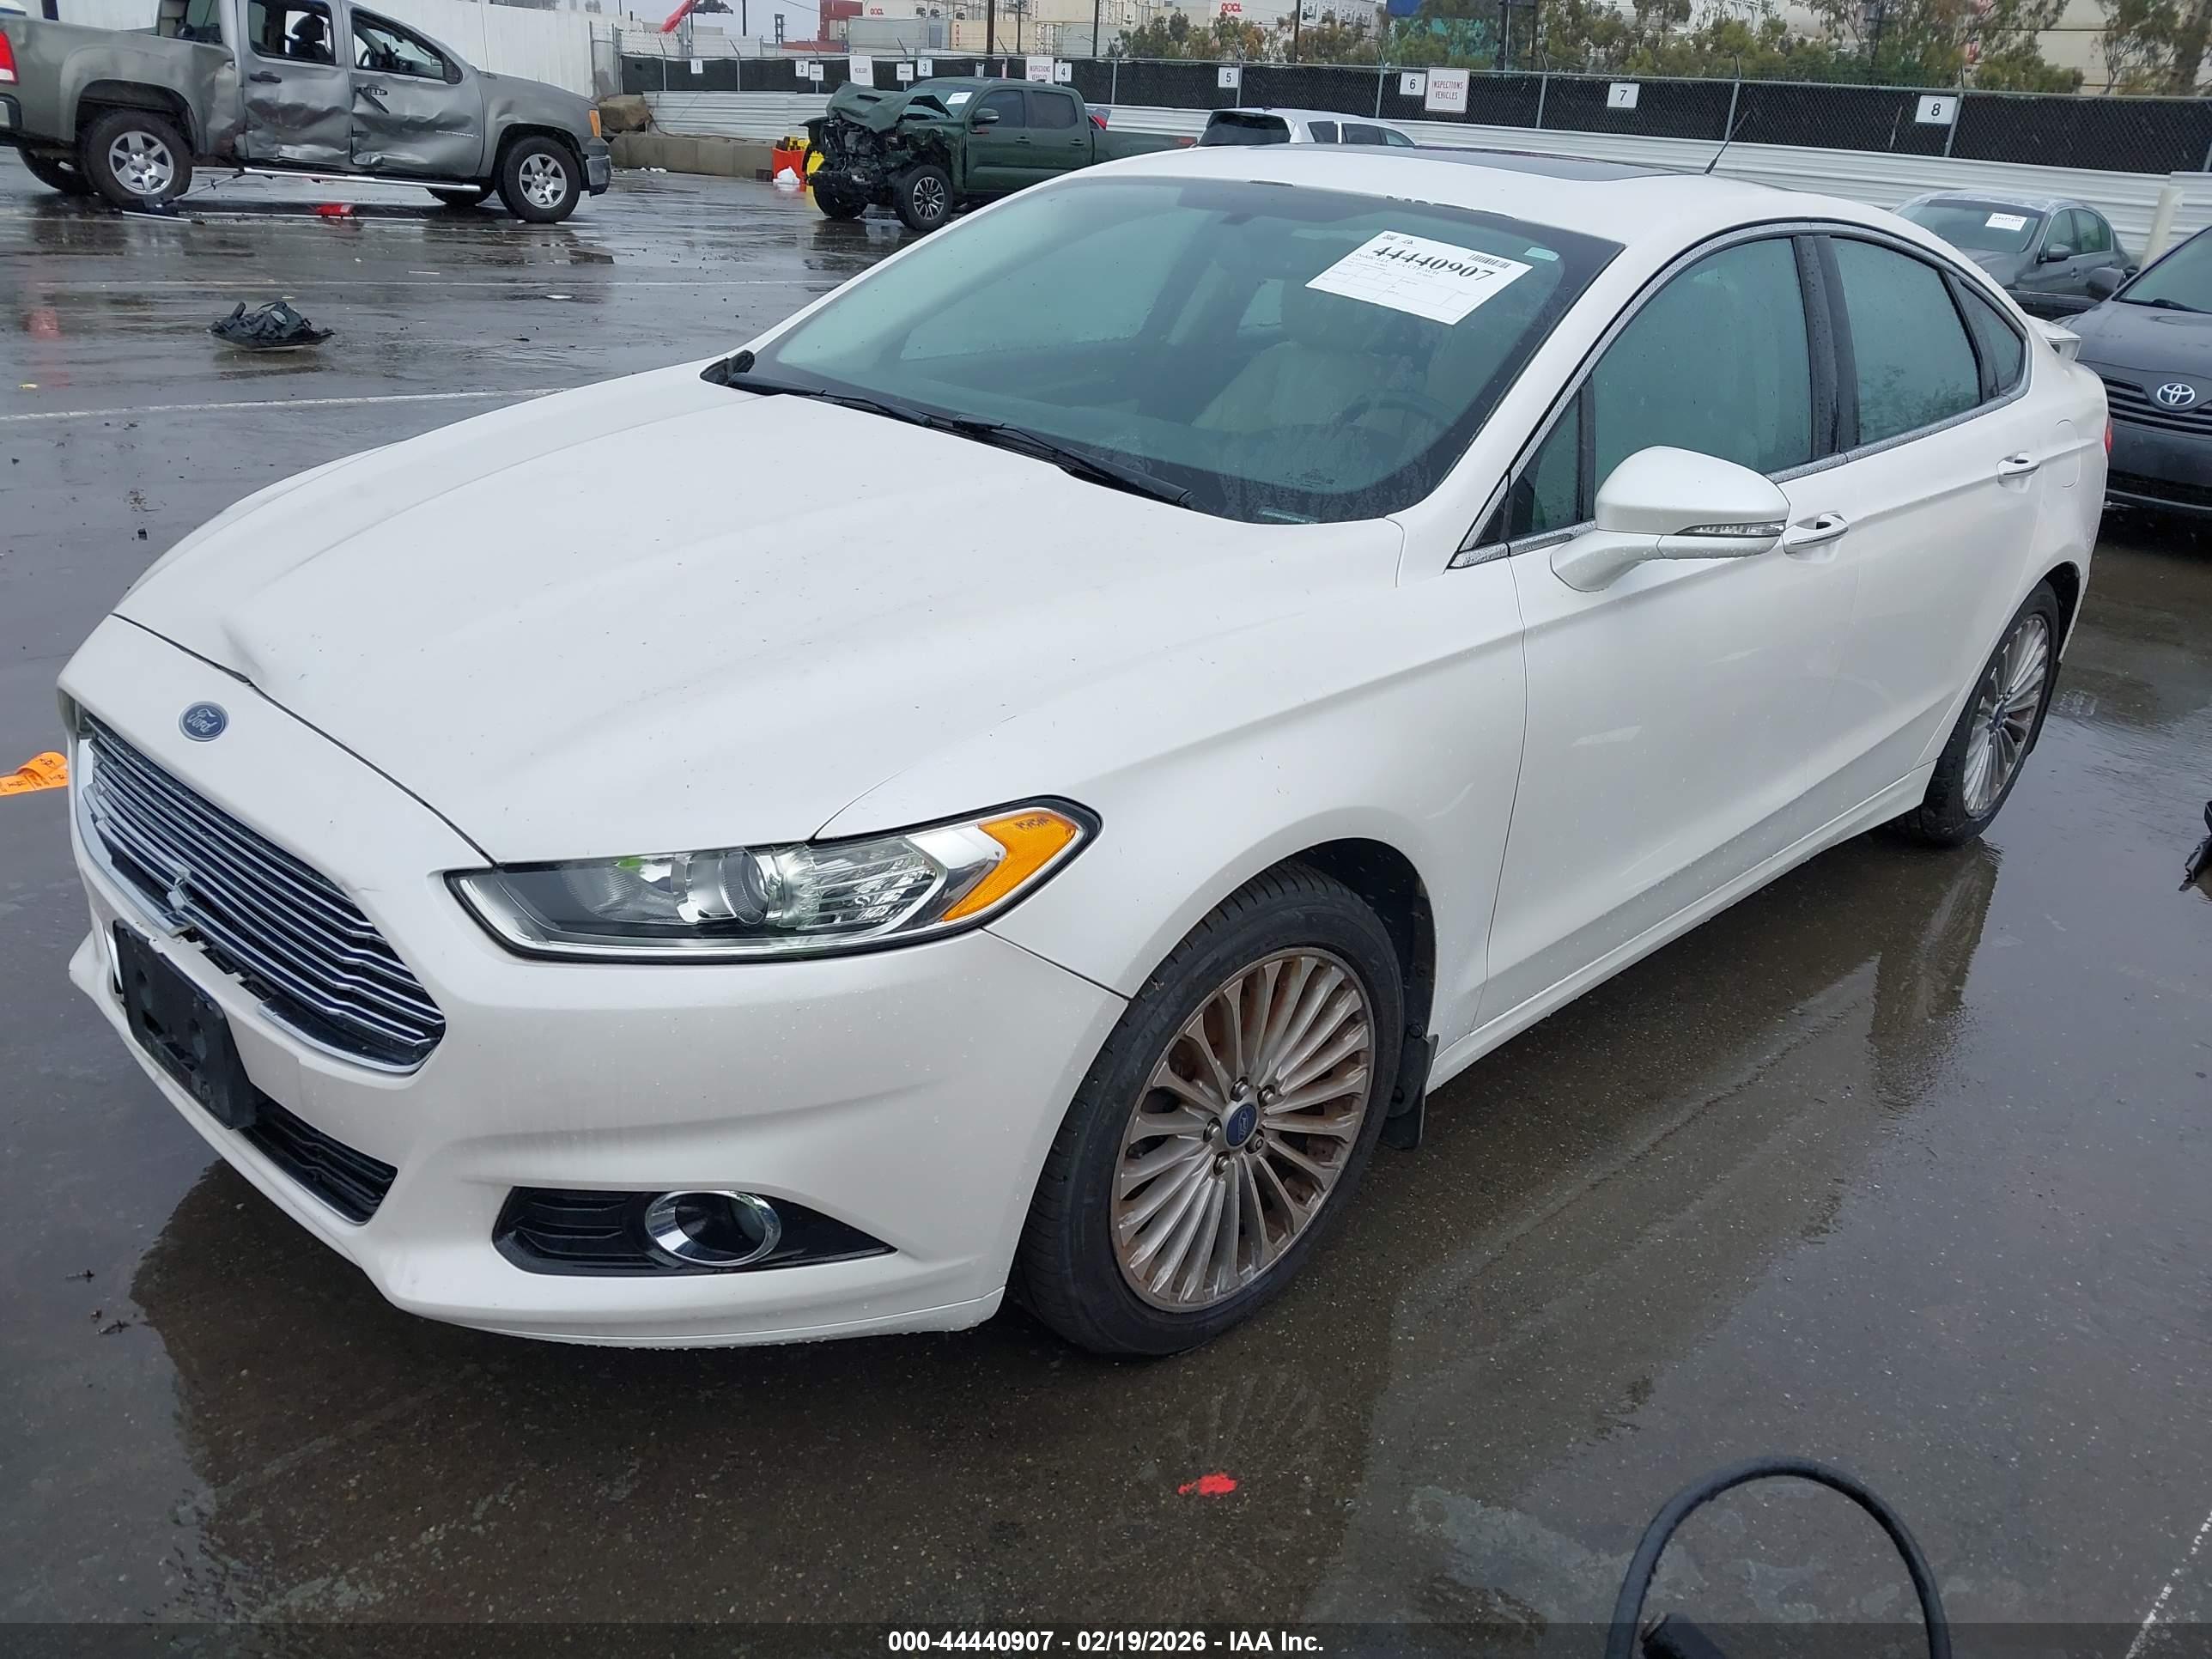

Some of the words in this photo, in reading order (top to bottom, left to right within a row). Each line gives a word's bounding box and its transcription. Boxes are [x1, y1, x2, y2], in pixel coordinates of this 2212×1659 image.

[799, 64, 805, 73] 2
[922, 64, 927, 72] 3
[1060, 68, 1066, 77] 4
[1226, 72, 1231, 82] 5
[1409, 78, 1417, 89] 6
[1431, 80, 1463, 89] INSPECTIONS
[1435, 91, 1458, 100] VEHICLES
[1620, 89, 1628, 101] 7
[1931, 103, 1941, 116] 8
[1373, 246, 1497, 281] 44440907
[187, 708, 218, 733] Ford
